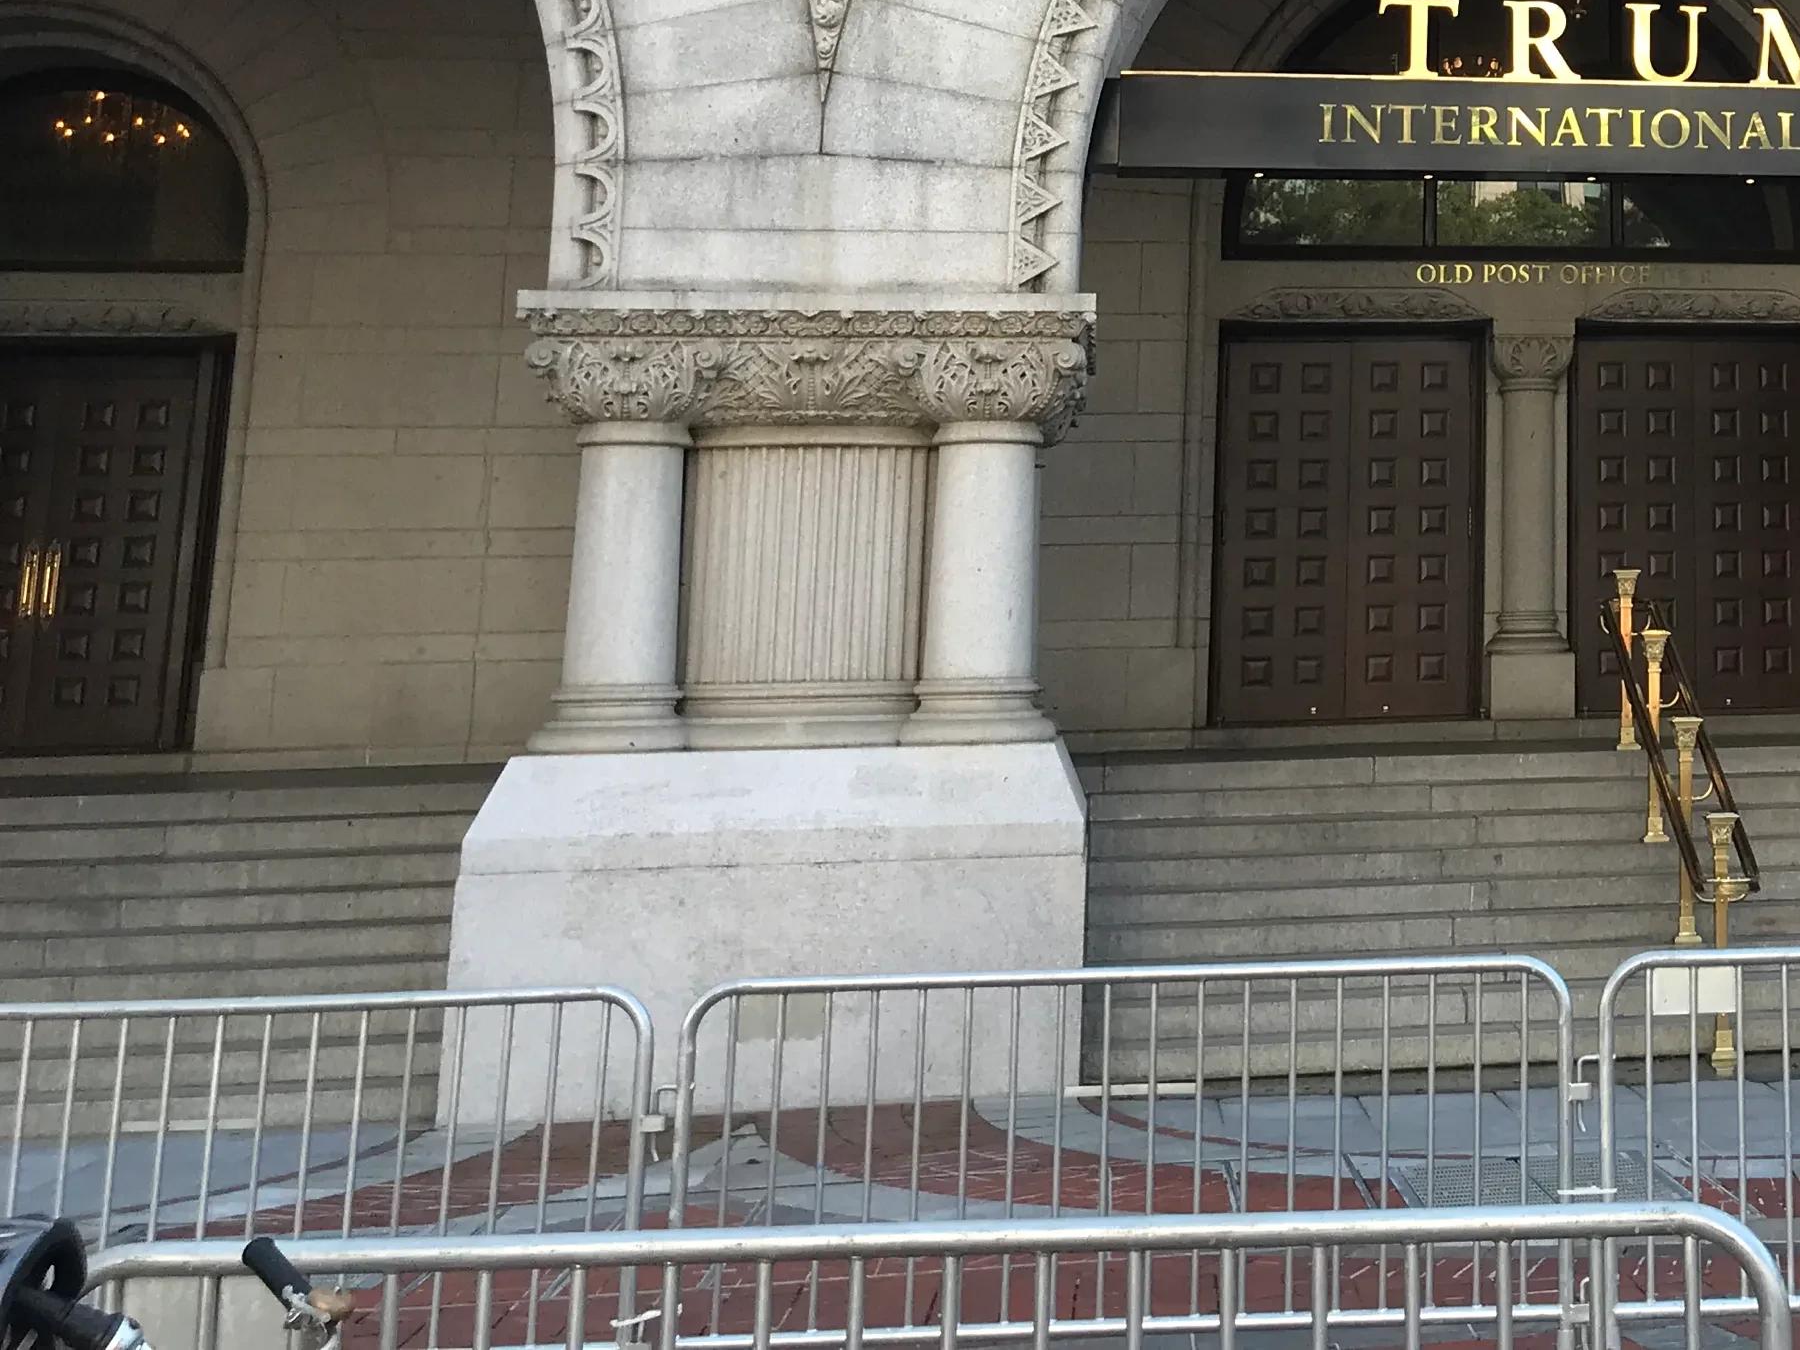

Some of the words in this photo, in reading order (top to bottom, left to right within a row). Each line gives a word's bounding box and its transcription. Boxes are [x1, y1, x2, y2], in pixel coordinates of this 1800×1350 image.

[1416, 263, 1473, 284] OLD
[1482, 263, 1550, 284] POST
[1560, 264, 1651, 285] OFFICE
